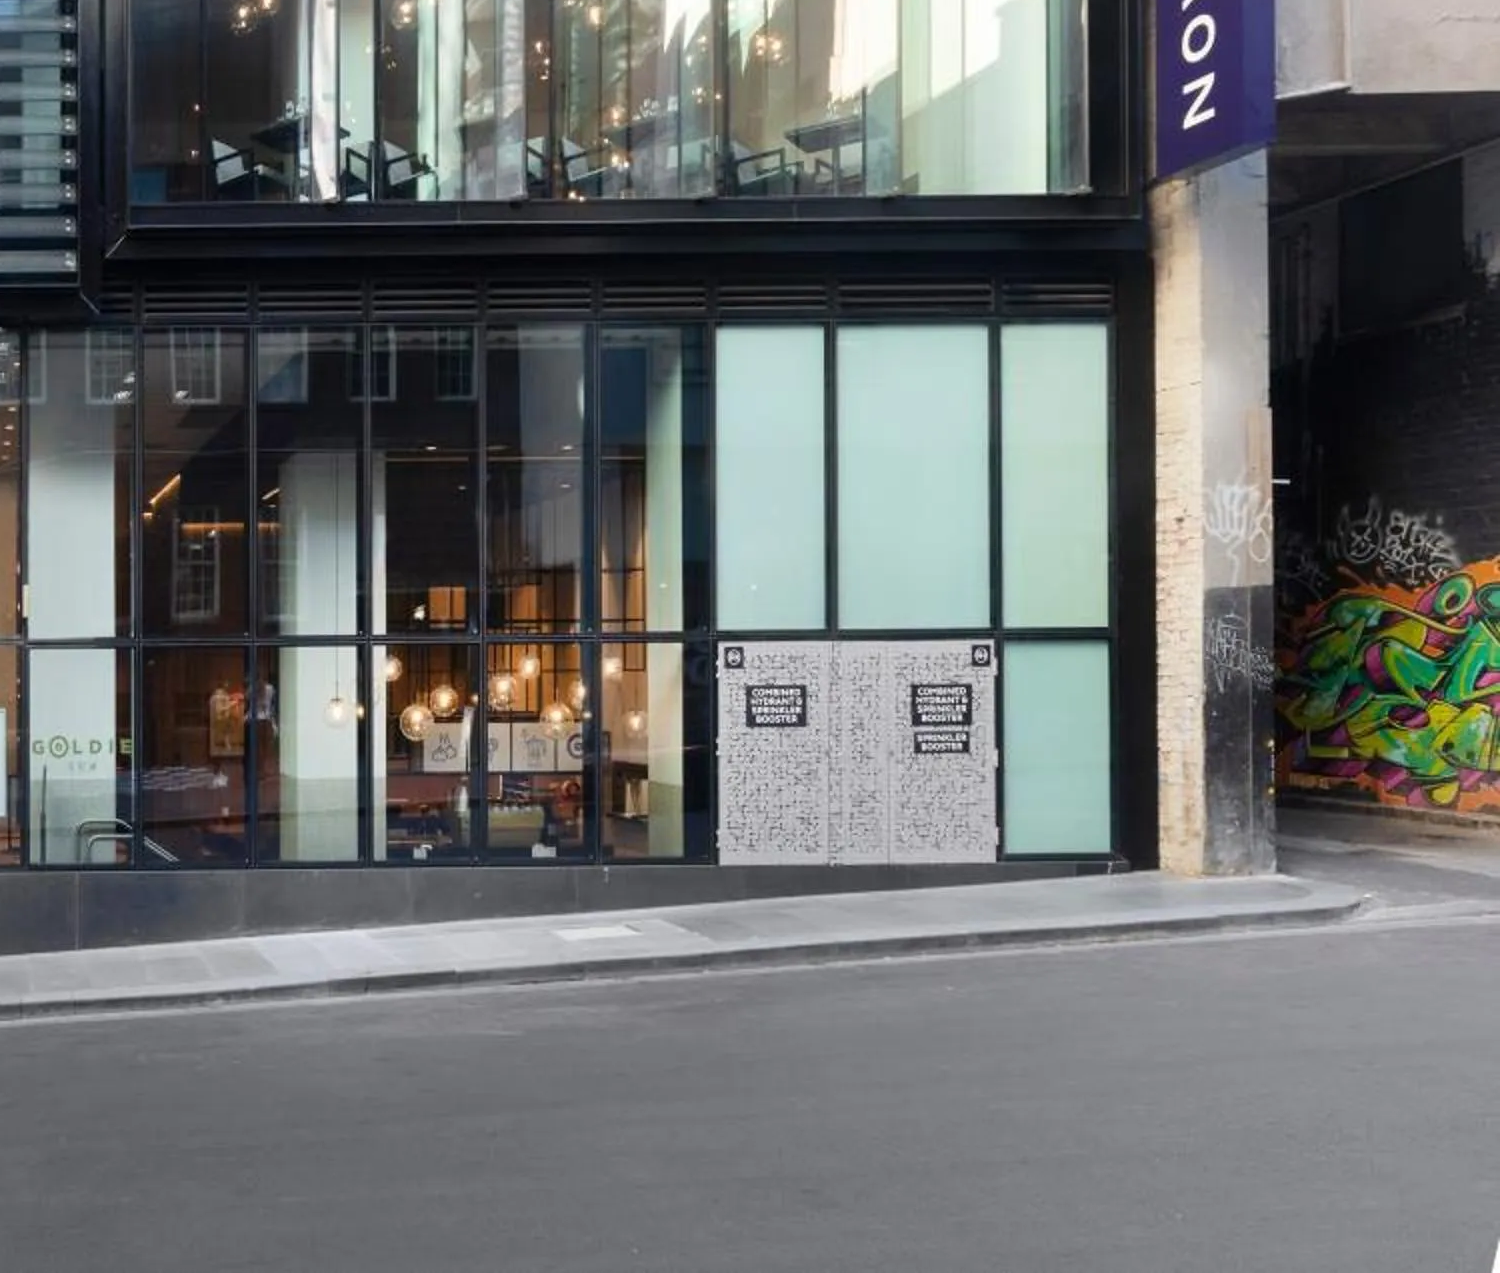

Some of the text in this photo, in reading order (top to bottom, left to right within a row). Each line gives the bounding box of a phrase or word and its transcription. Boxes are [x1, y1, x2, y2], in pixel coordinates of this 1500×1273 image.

[751, 688, 802, 697] COMBINED
[917, 687, 967, 696] COMBINED
[750, 697, 794, 706] HYDRANT
[915, 696, 959, 704] HYDRANT
[751, 706, 802, 715] SPRINKLER
[917, 704, 967, 714] SPRINKLER
[755, 714, 798, 724] BOOSTER
[921, 714, 963, 723] BOOSTER
[916, 733, 967, 742] SPRINKLER
[32, 735, 133, 759] GOLDIE
[921, 742, 963, 752] BOOSTER
